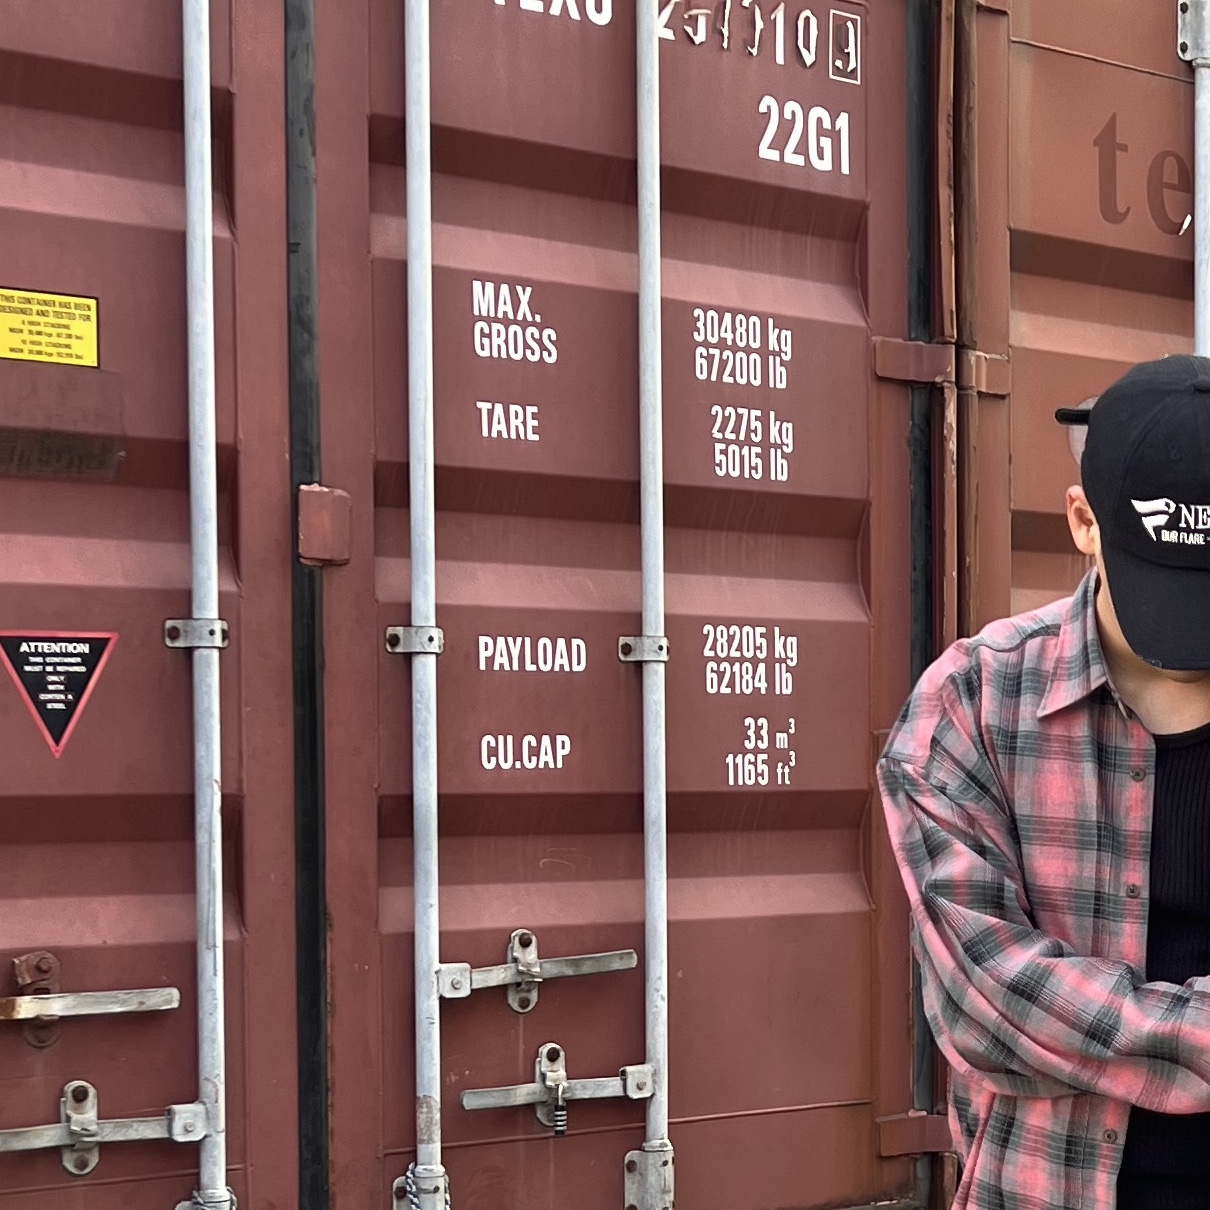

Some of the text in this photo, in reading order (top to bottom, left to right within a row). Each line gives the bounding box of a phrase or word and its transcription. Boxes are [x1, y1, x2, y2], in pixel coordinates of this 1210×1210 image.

[758, 95, 850, 175] 22G1
[472, 279, 542, 322] MAX.
[473, 320, 558, 364] GROSS
[692, 308, 792, 364] 30480 kg
[695, 344, 790, 390] 67200 lb
[476, 401, 794, 457] TARE 2275 kg
[714, 439, 791, 482] 5015 lb
[19, 641, 90, 654] ATTENTION
[478, 624, 798, 672] PAYLOAD 28205 kg
[705, 659, 796, 695] 62184 lb
[481, 734, 571, 770] CU.CAP
[743, 716, 769, 750] 33
[725, 752, 769, 786] 1165
